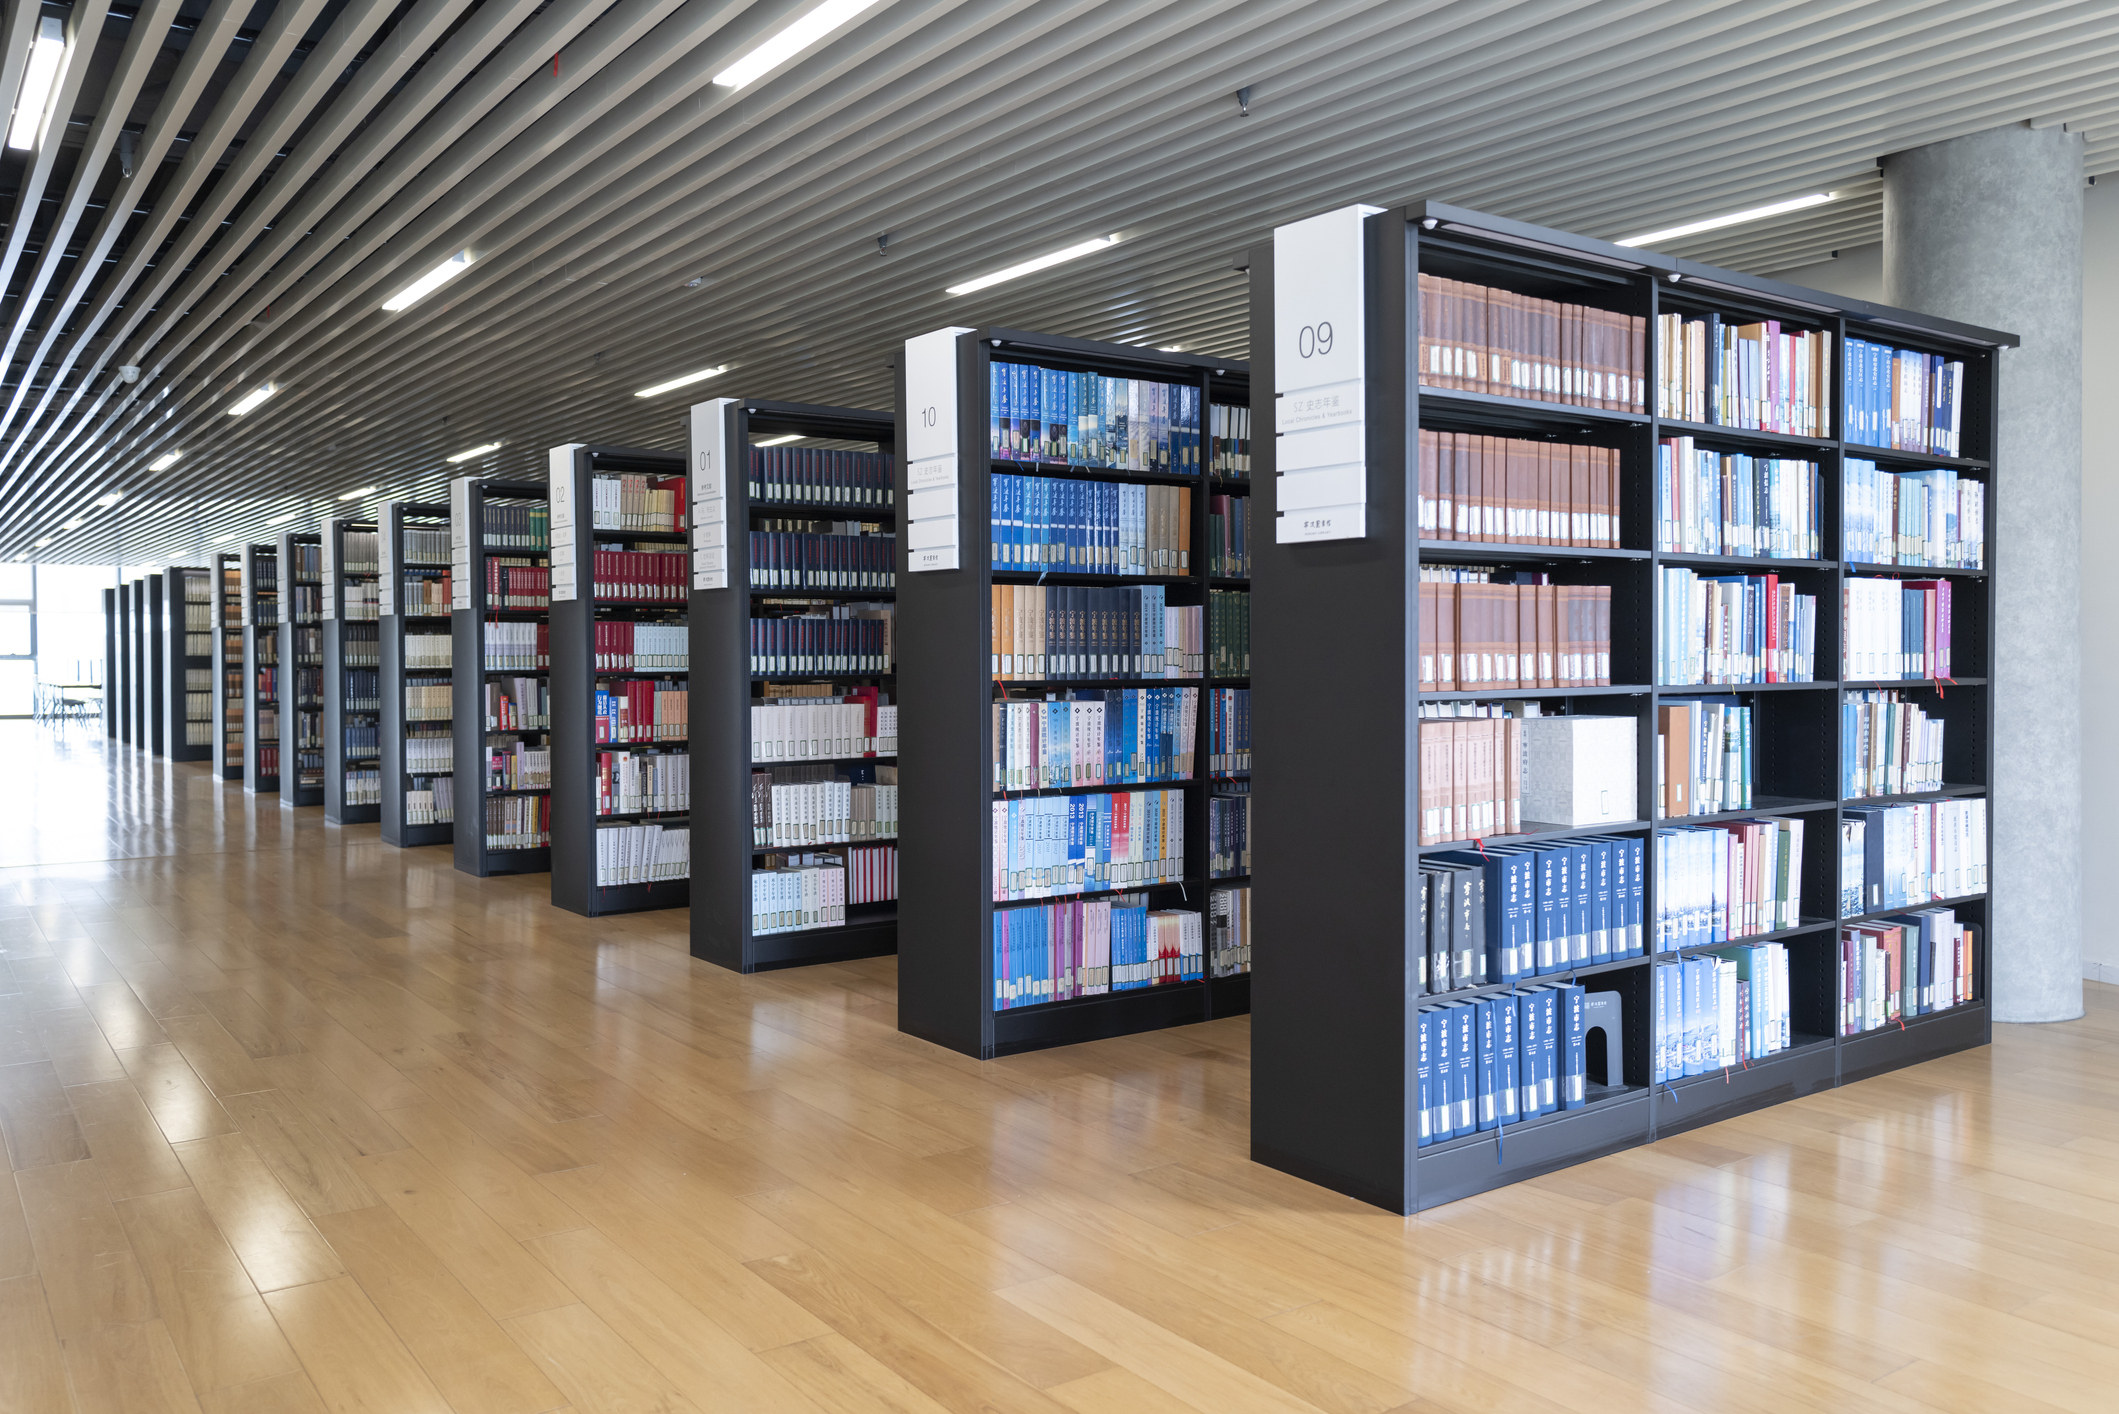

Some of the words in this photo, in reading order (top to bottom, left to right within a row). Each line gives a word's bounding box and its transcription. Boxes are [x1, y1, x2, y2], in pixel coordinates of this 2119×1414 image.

[1299, 321, 1334, 359] 09
[921, 406, 936, 428] 10
[1296, 414, 1321, 423] Chronicles
[1327, 409, 1353, 417] Yearbooks
[700, 450, 711, 471] 01
[556, 487, 565, 503] 02
[455, 513, 462, 527] 03
